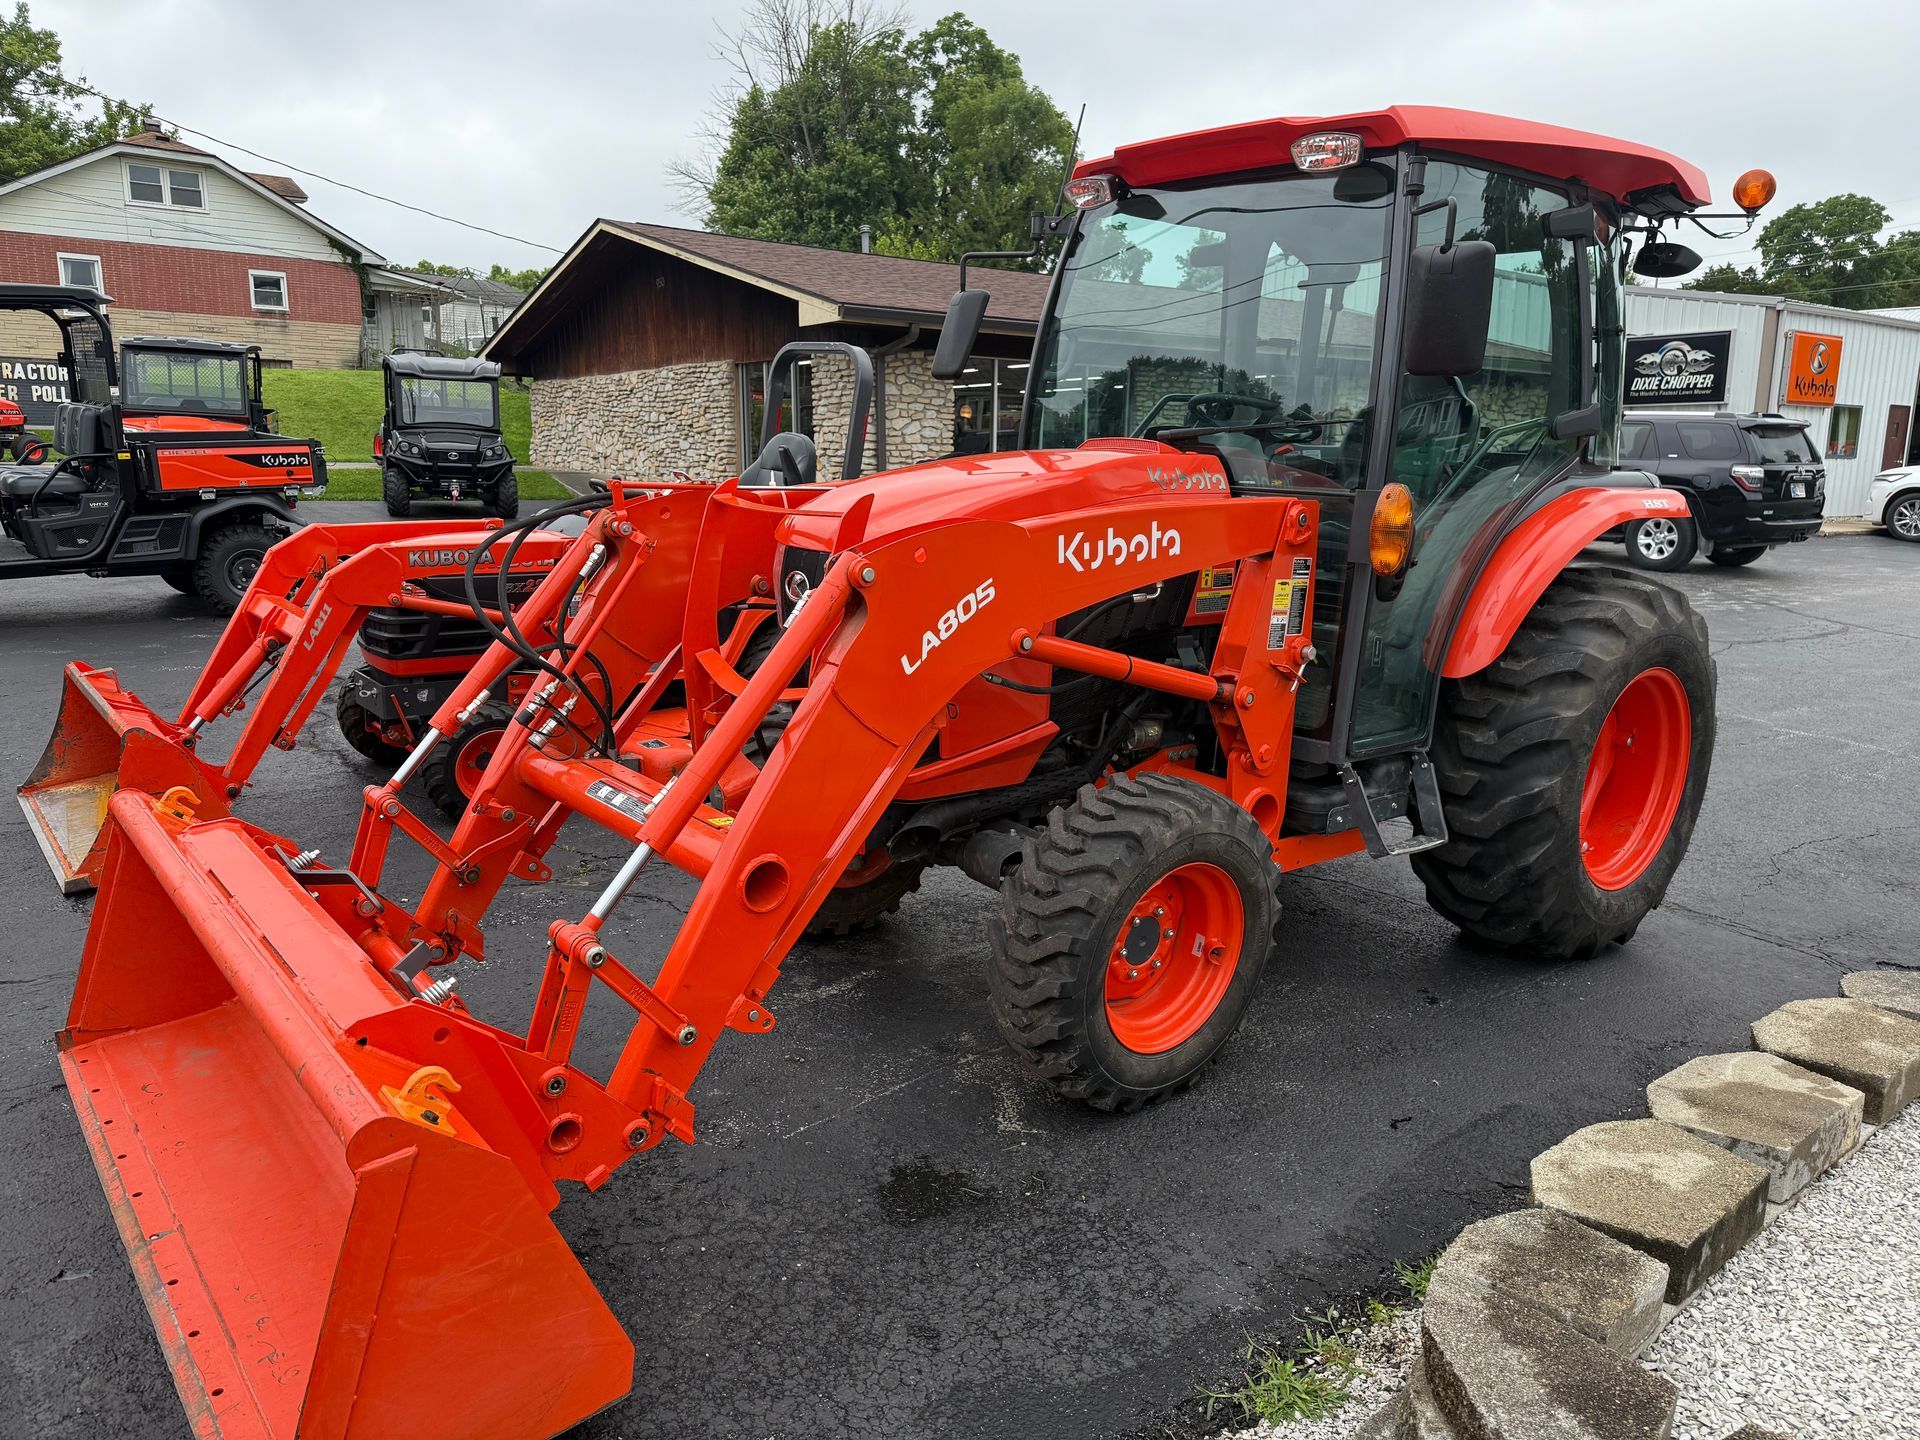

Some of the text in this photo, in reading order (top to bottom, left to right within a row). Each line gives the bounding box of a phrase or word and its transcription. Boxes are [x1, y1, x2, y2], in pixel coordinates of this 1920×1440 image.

[0, 362, 69, 381] RACTOR
[1630, 374, 1714, 391] DIXIE CHOPPER
[1795, 376, 1835, 397] Kubota
[31, 385, 71, 402] POLL
[261, 455, 309, 466] Kubota
[1147, 466, 1226, 490] Kubota
[1058, 520, 1181, 572] Kubota
[408, 549, 494, 567] KUBOA
[900, 577, 996, 675] LA805
